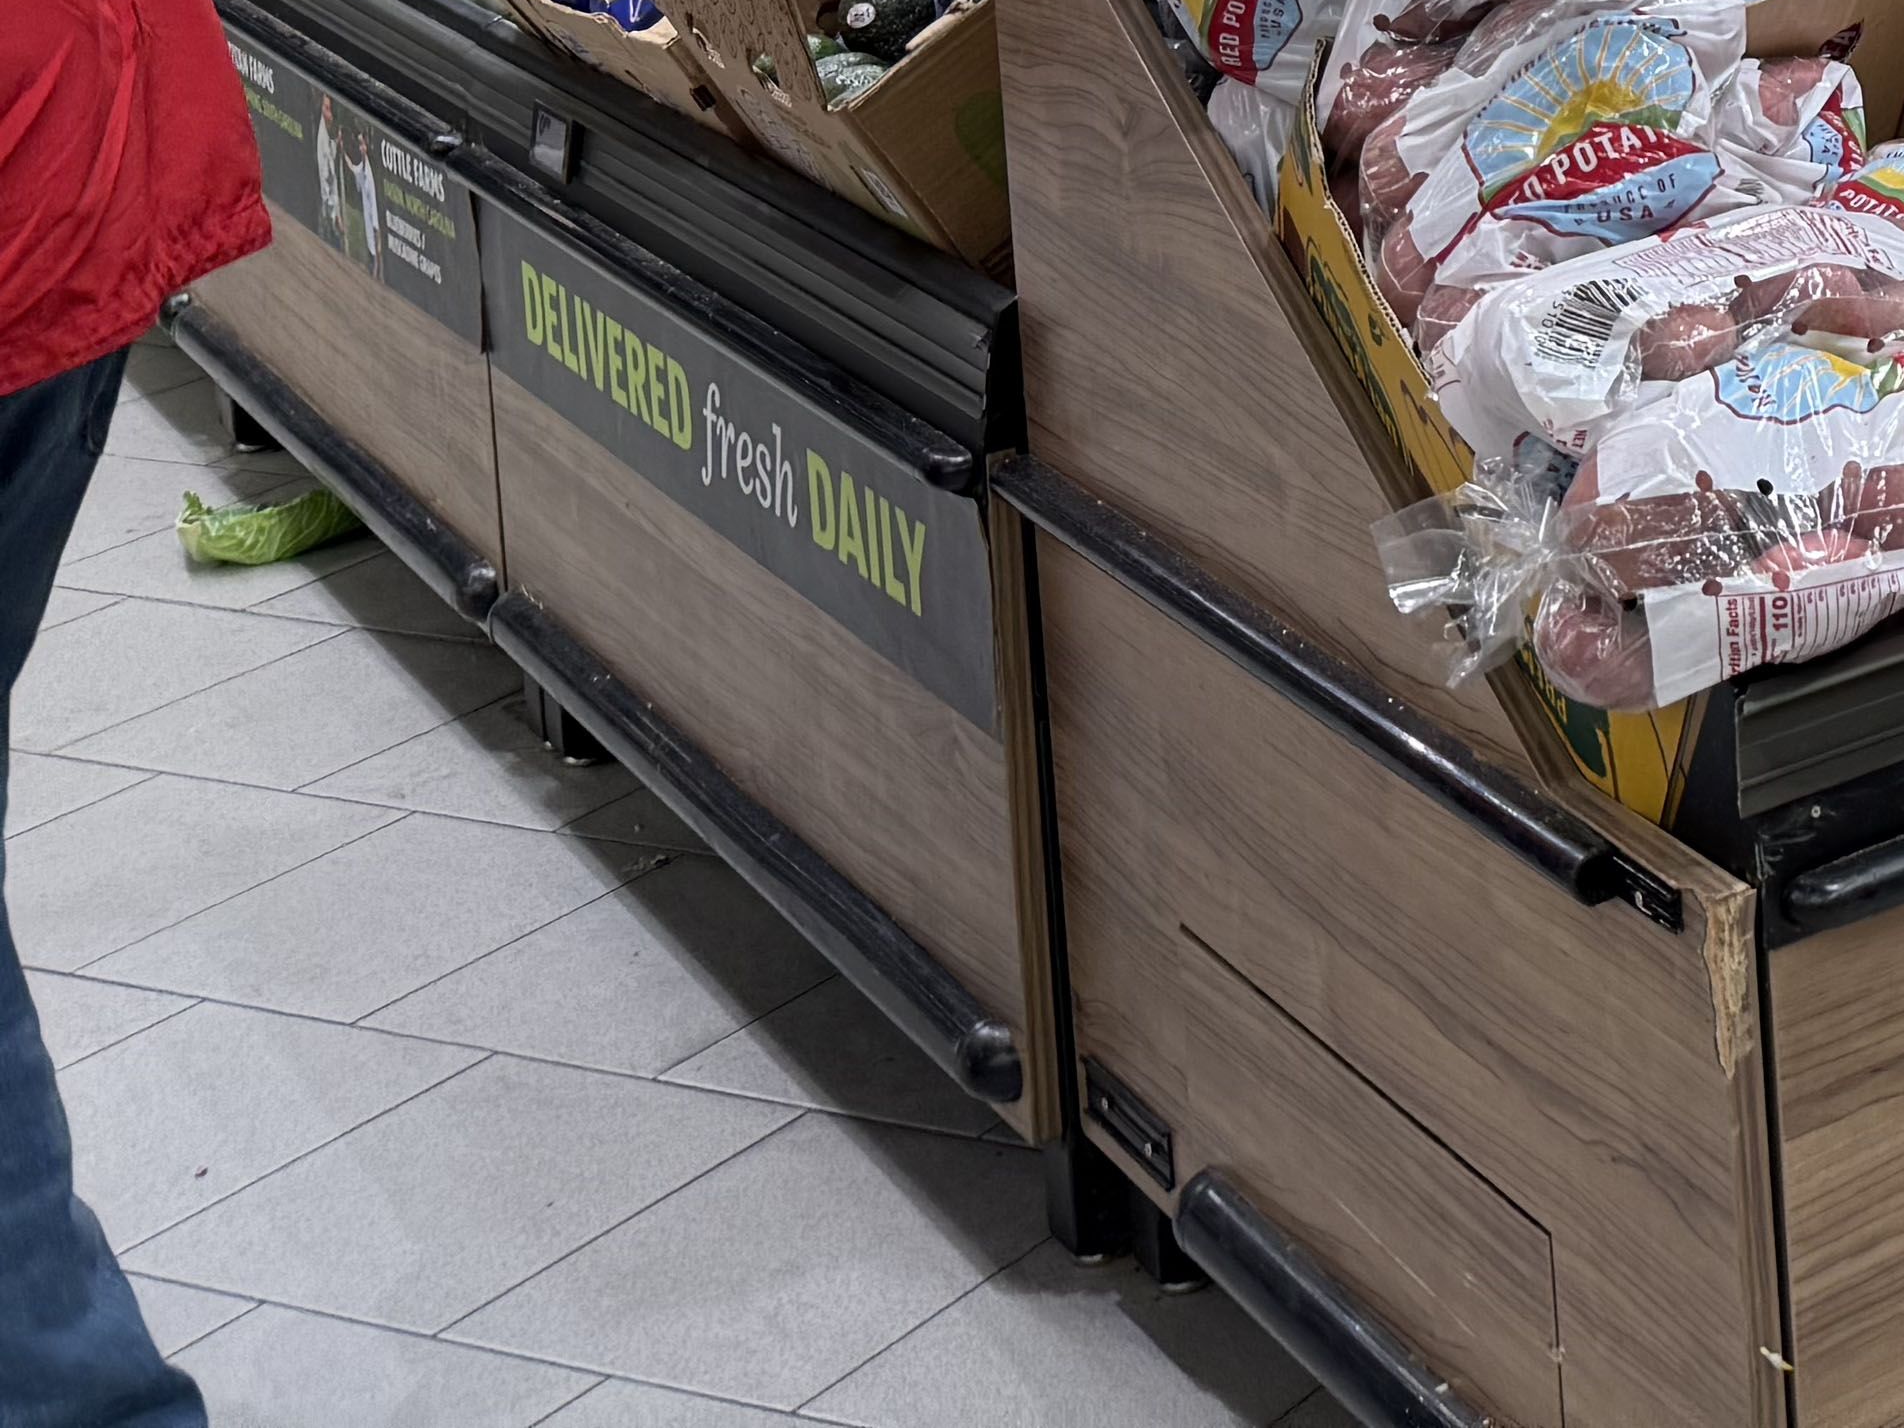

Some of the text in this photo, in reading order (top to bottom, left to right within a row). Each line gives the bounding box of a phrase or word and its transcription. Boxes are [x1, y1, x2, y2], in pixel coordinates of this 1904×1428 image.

[1217, 38, 1244, 69] RED
[381, 138, 413, 184] COTTLE
[412, 157, 445, 203] FARMS
[1656, 172, 1678, 194] OF
[1596, 206, 1655, 224] USA
[520, 259, 929, 618] DELIVERED fresh DAILY
[1728, 597, 1741, 641] Facts
[1771, 594, 1788, 633] 110
